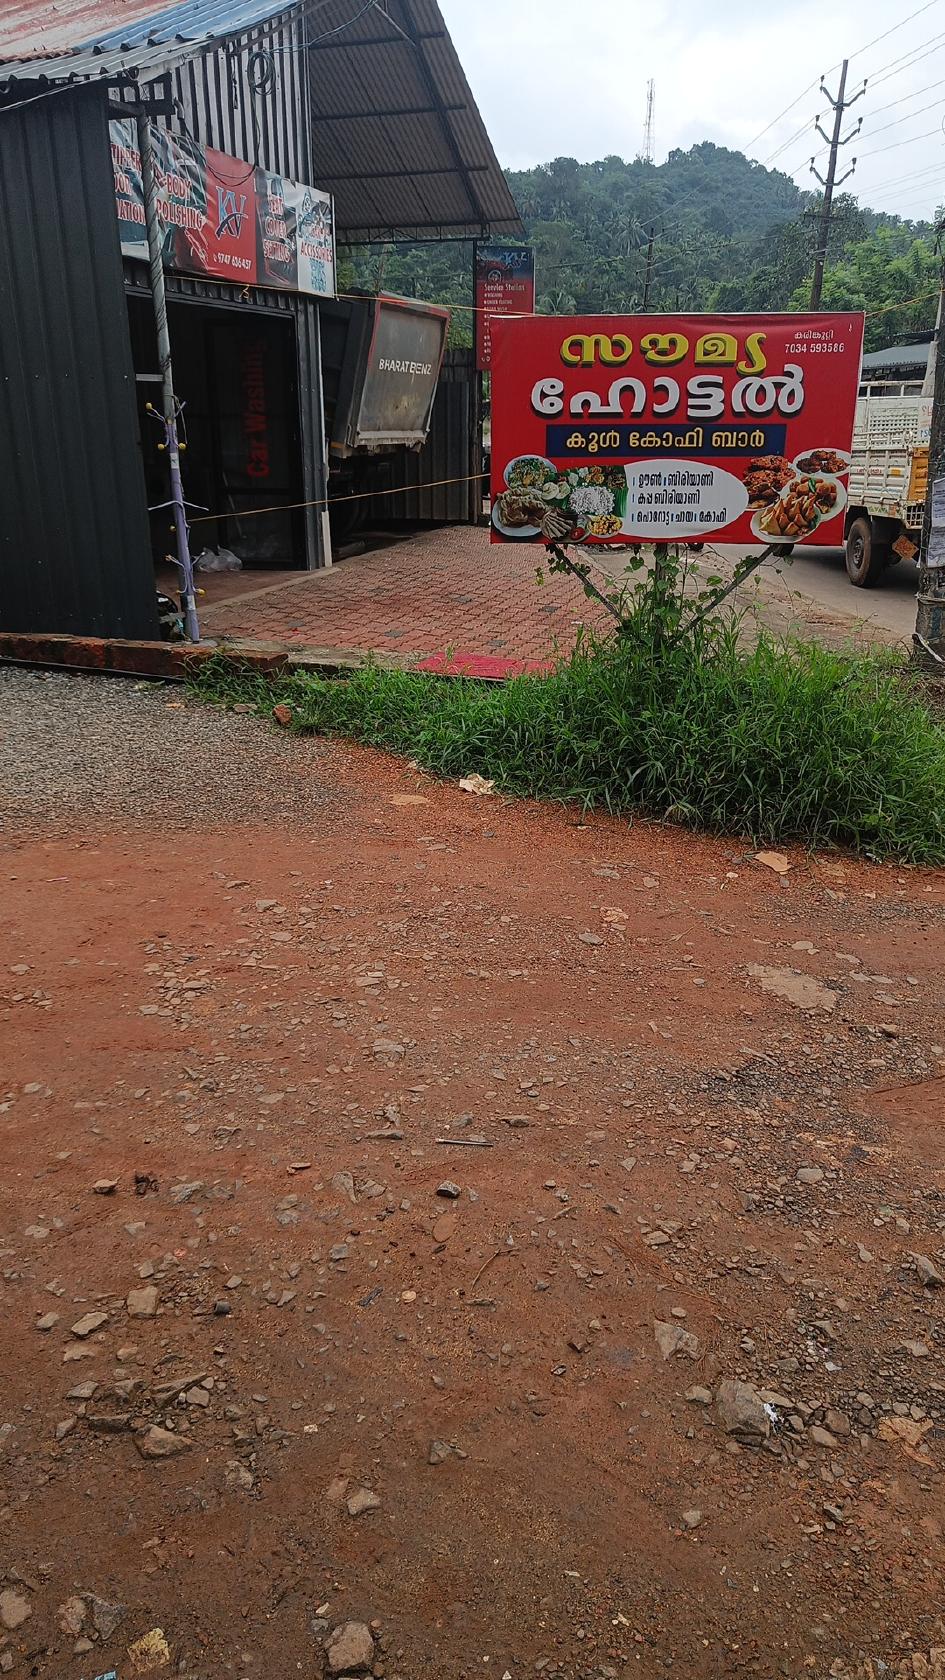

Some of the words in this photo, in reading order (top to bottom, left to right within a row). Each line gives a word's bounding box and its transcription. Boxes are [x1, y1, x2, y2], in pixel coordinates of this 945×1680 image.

[166, 172, 192, 200] BODY
[156, 198, 204, 231] POLISHING
[785, 343, 807, 353] 7034
[810, 343, 845, 353] 593586
[530, 364, 805, 419] ഹോട്ടൽ
[566, 430, 620, 453] കൂൾ
[628, 427, 703, 448] കോഫി
[711, 429, 766, 448] ബാർ
[246, 438, 270, 478] Car
[667, 471, 714, 487] ബിരിയാണി
[654, 489, 701, 505] ബിരിയാണി
[675, 512, 694, 523] ചായ
[698, 508, 727, 523] കോഫി
